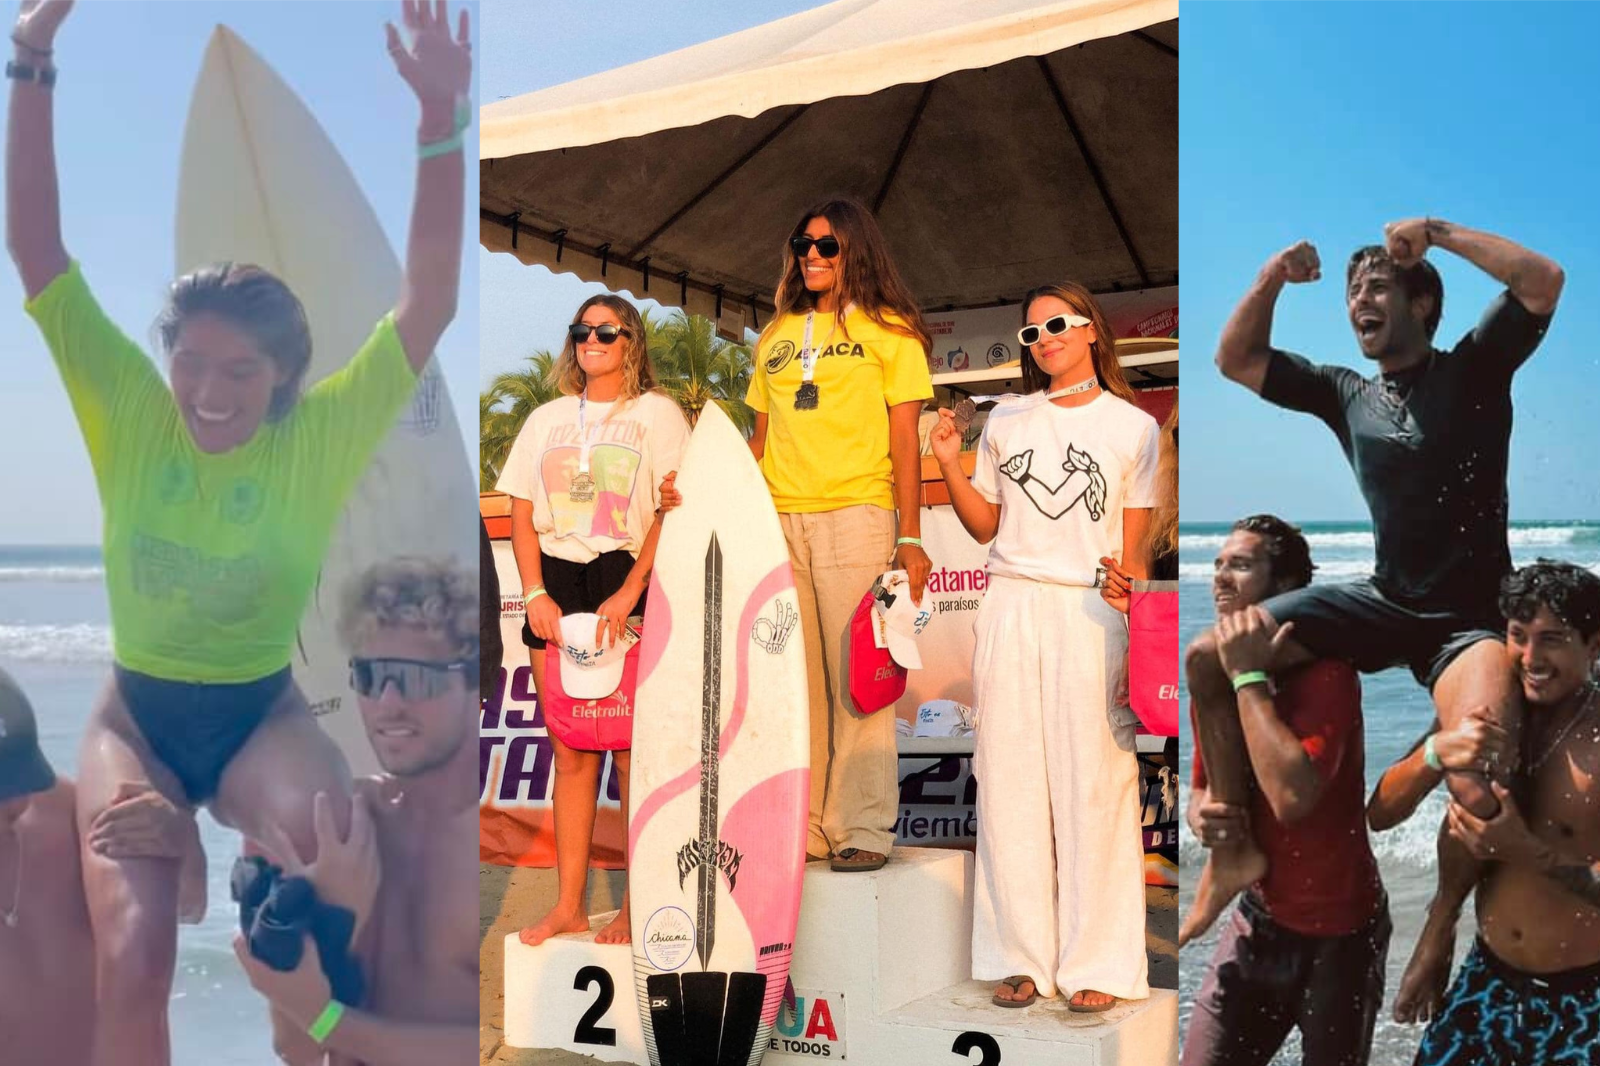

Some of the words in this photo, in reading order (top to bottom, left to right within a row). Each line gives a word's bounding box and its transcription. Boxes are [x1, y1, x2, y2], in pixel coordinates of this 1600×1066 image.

[939, 596, 980, 615] paraísos
[572, 703, 632, 719] Electrolit
[646, 931, 692, 944] Chicama
[573, 965, 616, 1047] 2
[782, 1039, 831, 1057] TODOS
